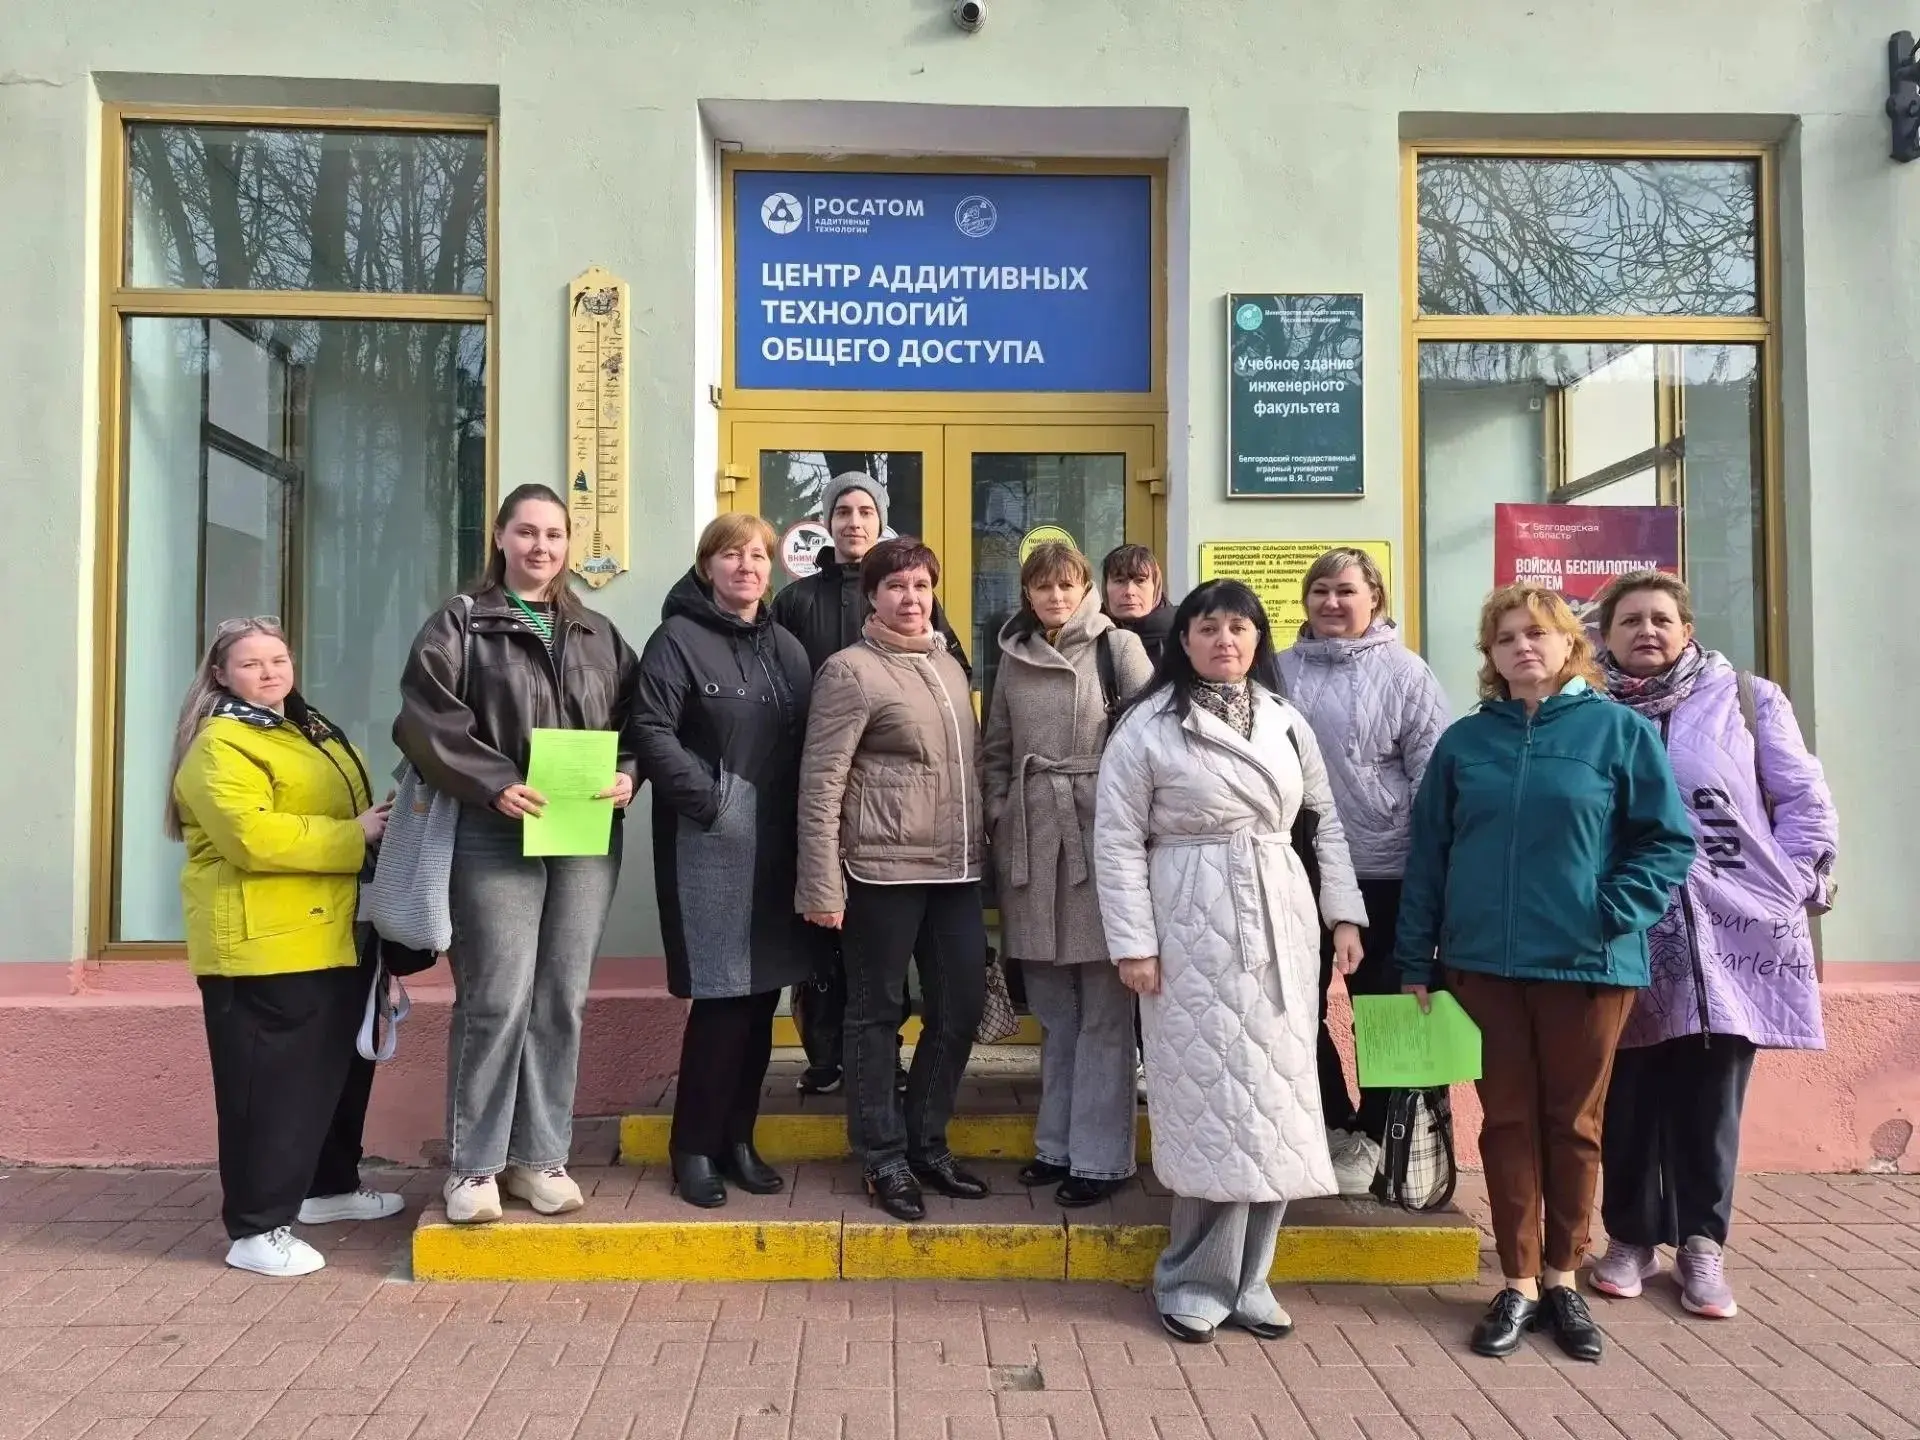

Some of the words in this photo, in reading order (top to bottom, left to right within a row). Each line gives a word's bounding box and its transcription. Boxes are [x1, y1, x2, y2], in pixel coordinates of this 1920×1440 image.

[814, 198, 924, 217] РОСАТОМ
[814, 218, 871, 226] АДДИТИВНЫЕ
[814, 226, 868, 234] ТЕХНОЛОГИИ
[761, 263, 861, 291] ЦЕНТР
[868, 265, 1088, 293] АДДИТИВНЫХ
[761, 296, 968, 326] ТЕХНОЛОГИЙ
[761, 337, 890, 366] ОБЩЕГО
[898, 340, 1045, 367] ДОСТУПА
[1238, 356, 1299, 371] Учебное
[1303, 359, 1354, 372] здание
[1249, 379, 1345, 395] инженерного
[1254, 400, 1340, 417] факультета
[1238, 454, 1290, 463] Белгородский
[1306, 475, 1333, 483] Горина
[1533, 522, 1599, 532] Белгородская
[1533, 532, 1571, 540] область
[1515, 557, 1562, 574] ВОЙСКА
[1565, 559, 1657, 575] БЕСПИЛОТНЫХ
[1692, 787, 1746, 879] GIRL
